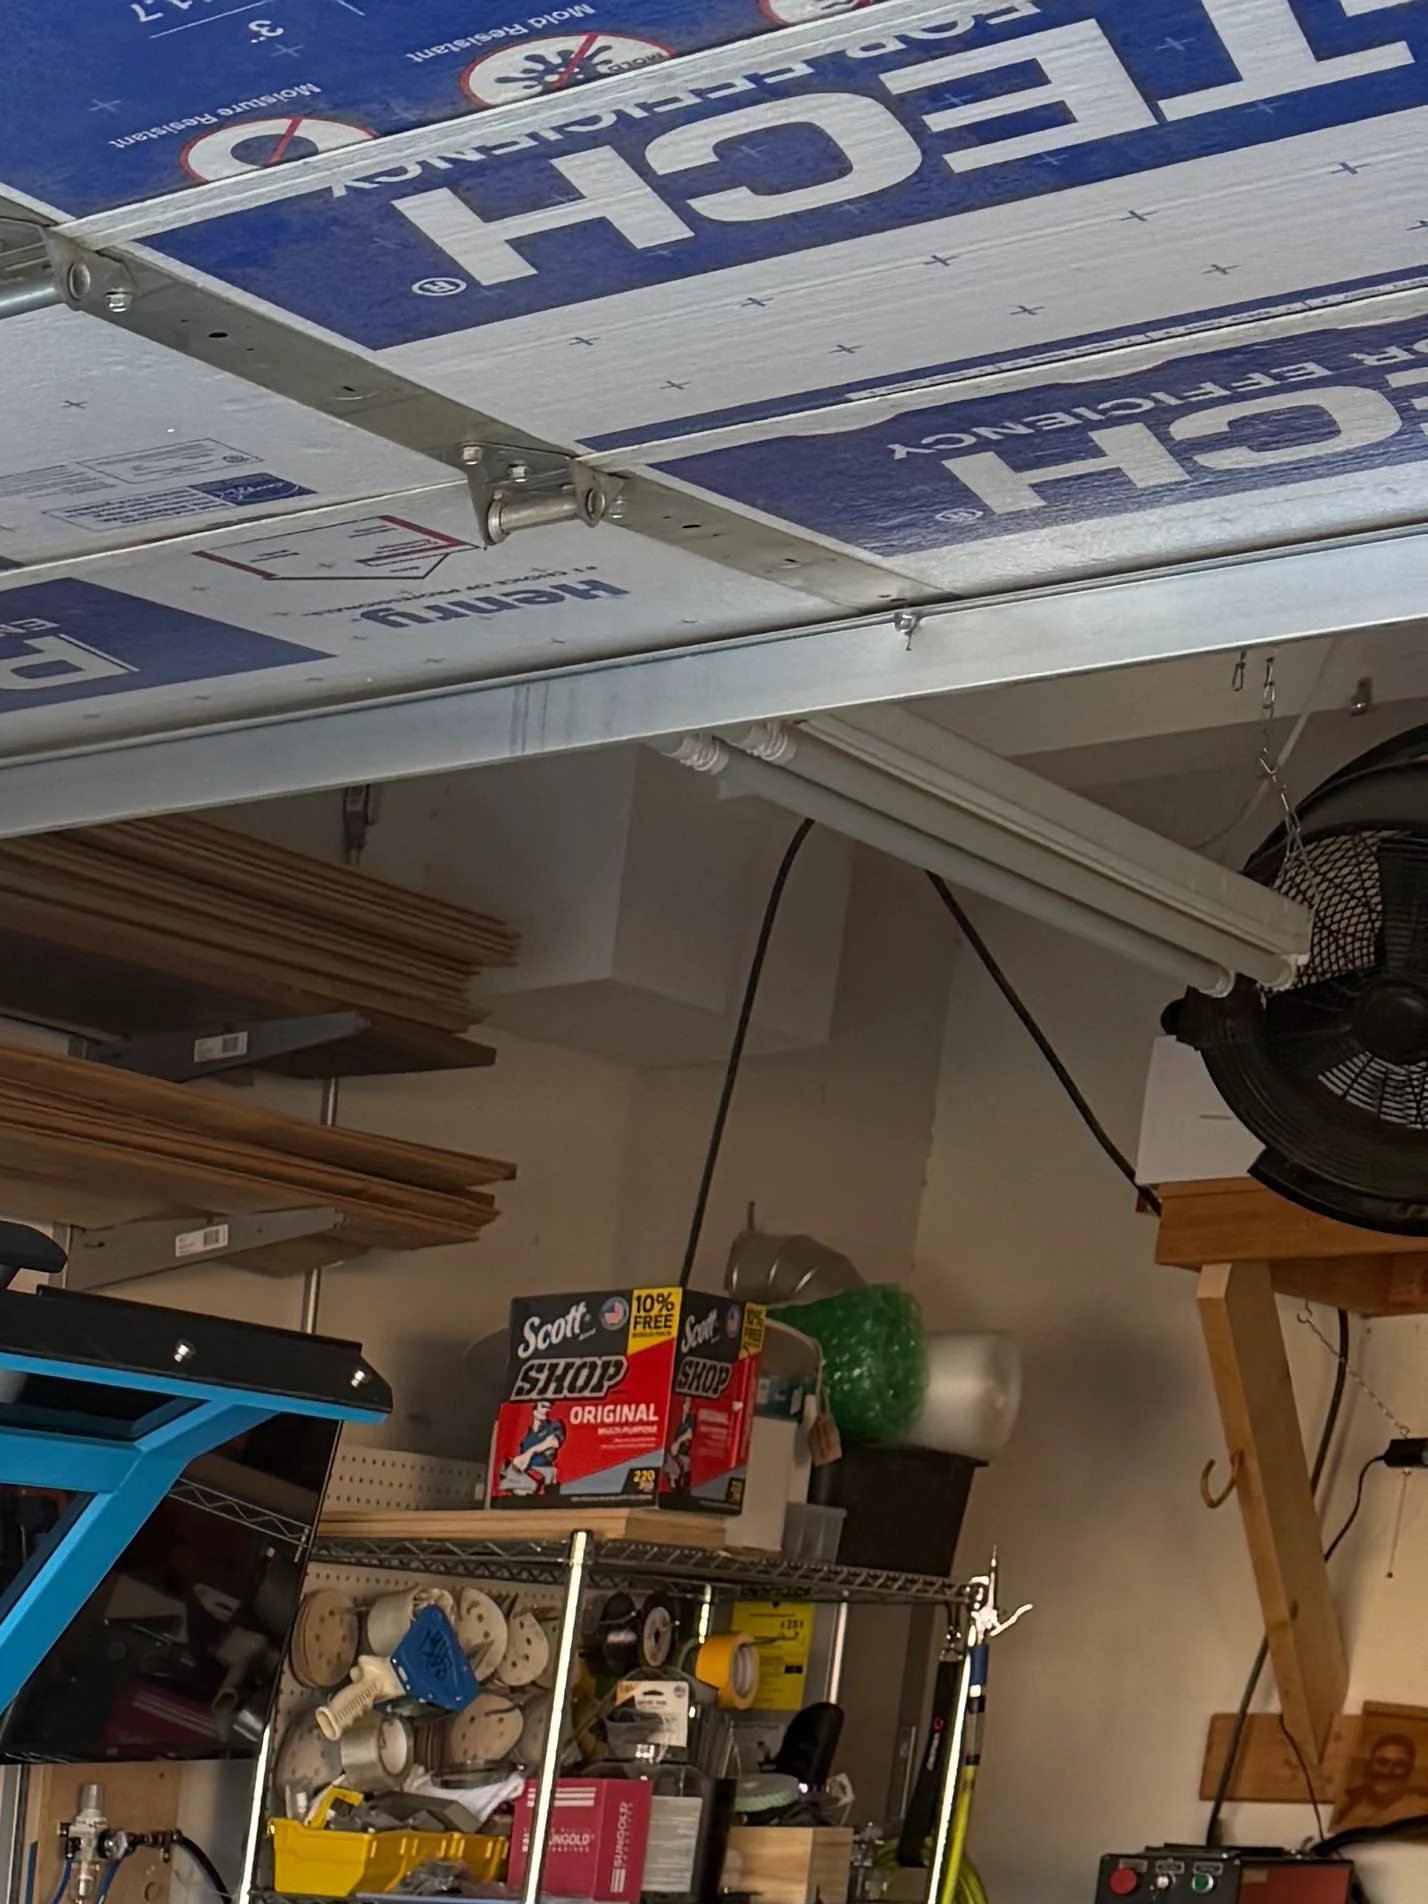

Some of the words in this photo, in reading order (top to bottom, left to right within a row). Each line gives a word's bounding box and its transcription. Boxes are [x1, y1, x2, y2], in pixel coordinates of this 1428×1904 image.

[529, 2, 597, 31] Mold
[406, 22, 528, 65] Resistant
[215, 83, 322, 118] Moisture
[109, 107, 214, 149] Resistant
[390, 0, 1416, 286] TECH
[888, 361, 1333, 460] EFFICIENCY
[360, 580, 631, 628] Henry
[632, 1314, 674, 1331] FREE
[634, 1292, 676, 1314] 10%
[517, 1301, 589, 1359] Scott
[681, 1308, 719, 1353] Scott
[510, 1355, 630, 1401] SHOP
[675, 1355, 733, 1399] SHOP
[569, 1402, 660, 1425] ORIGINAL
